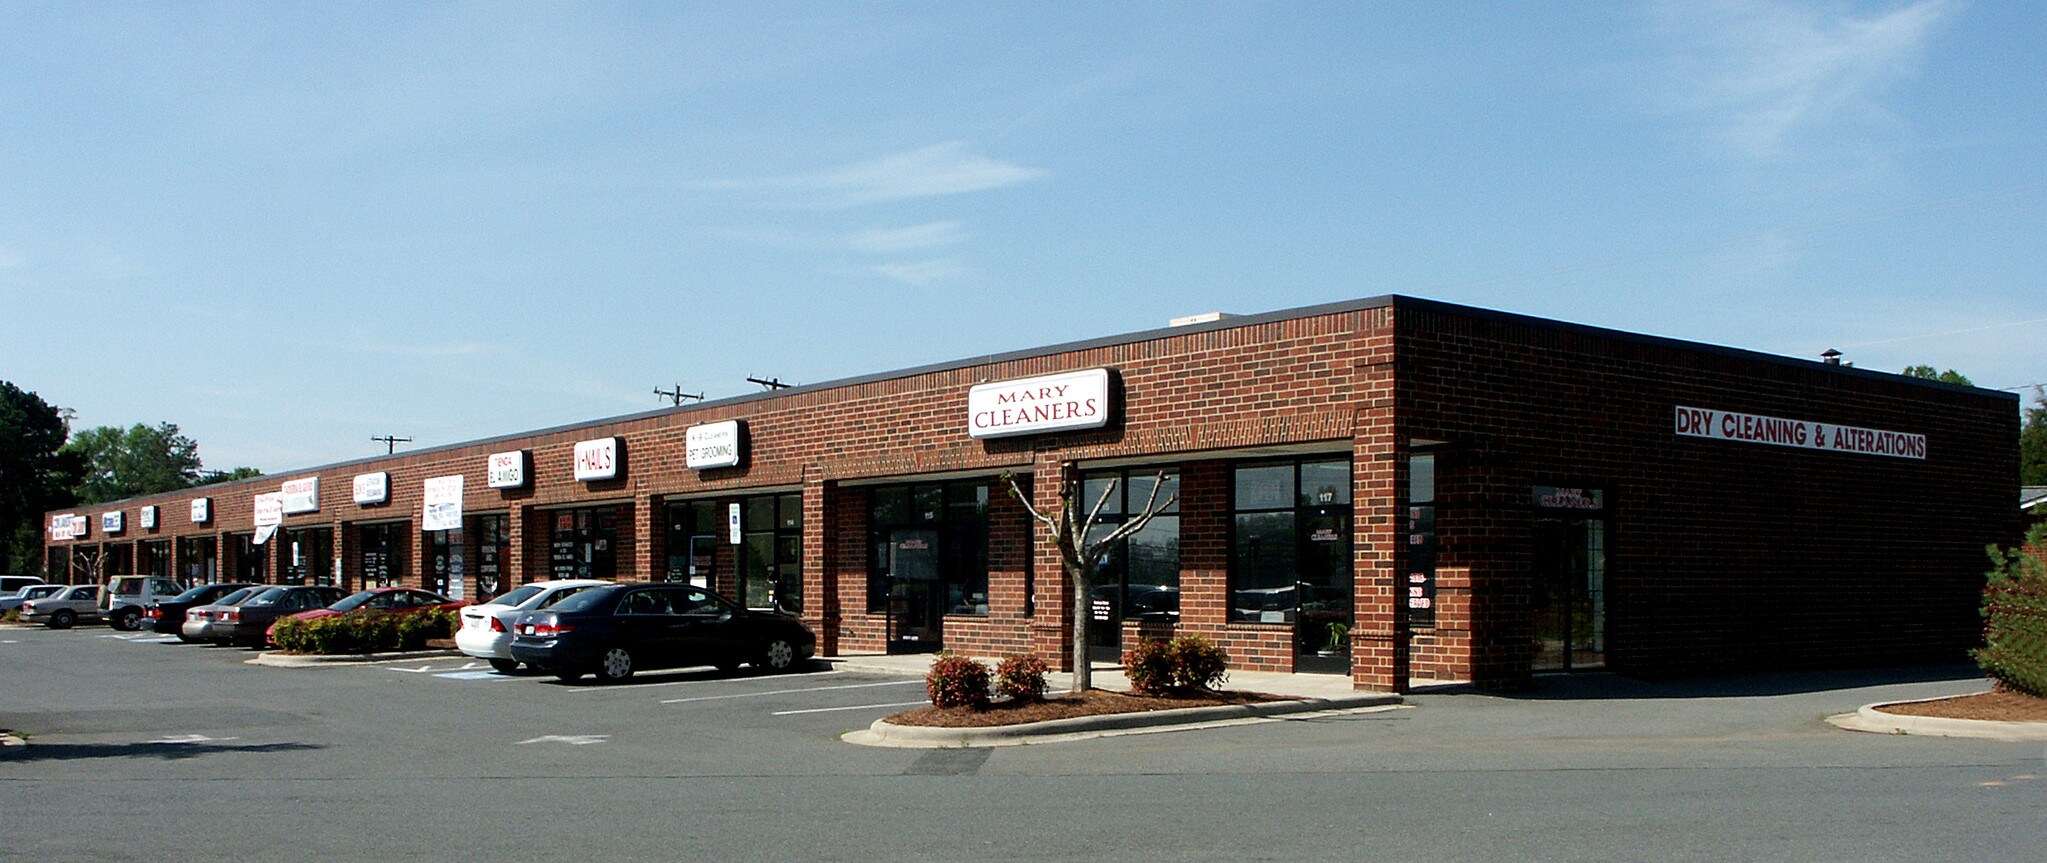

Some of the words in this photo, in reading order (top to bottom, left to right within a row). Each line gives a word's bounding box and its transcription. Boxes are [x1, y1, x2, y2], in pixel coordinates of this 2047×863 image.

[997, 384, 1069, 405] MARY
[975, 398, 1097, 429] CLEANERS
[1676, 408, 1713, 435] DRY
[1722, 414, 1806, 445] CLEANING
[1814, 425, 1825, 447] &
[1833, 427, 1924, 457] ALTERATIONS
[689, 448, 699, 460] PET
[701, 443, 732, 459] GROOMING
[1319, 492, 1333, 502] 117
